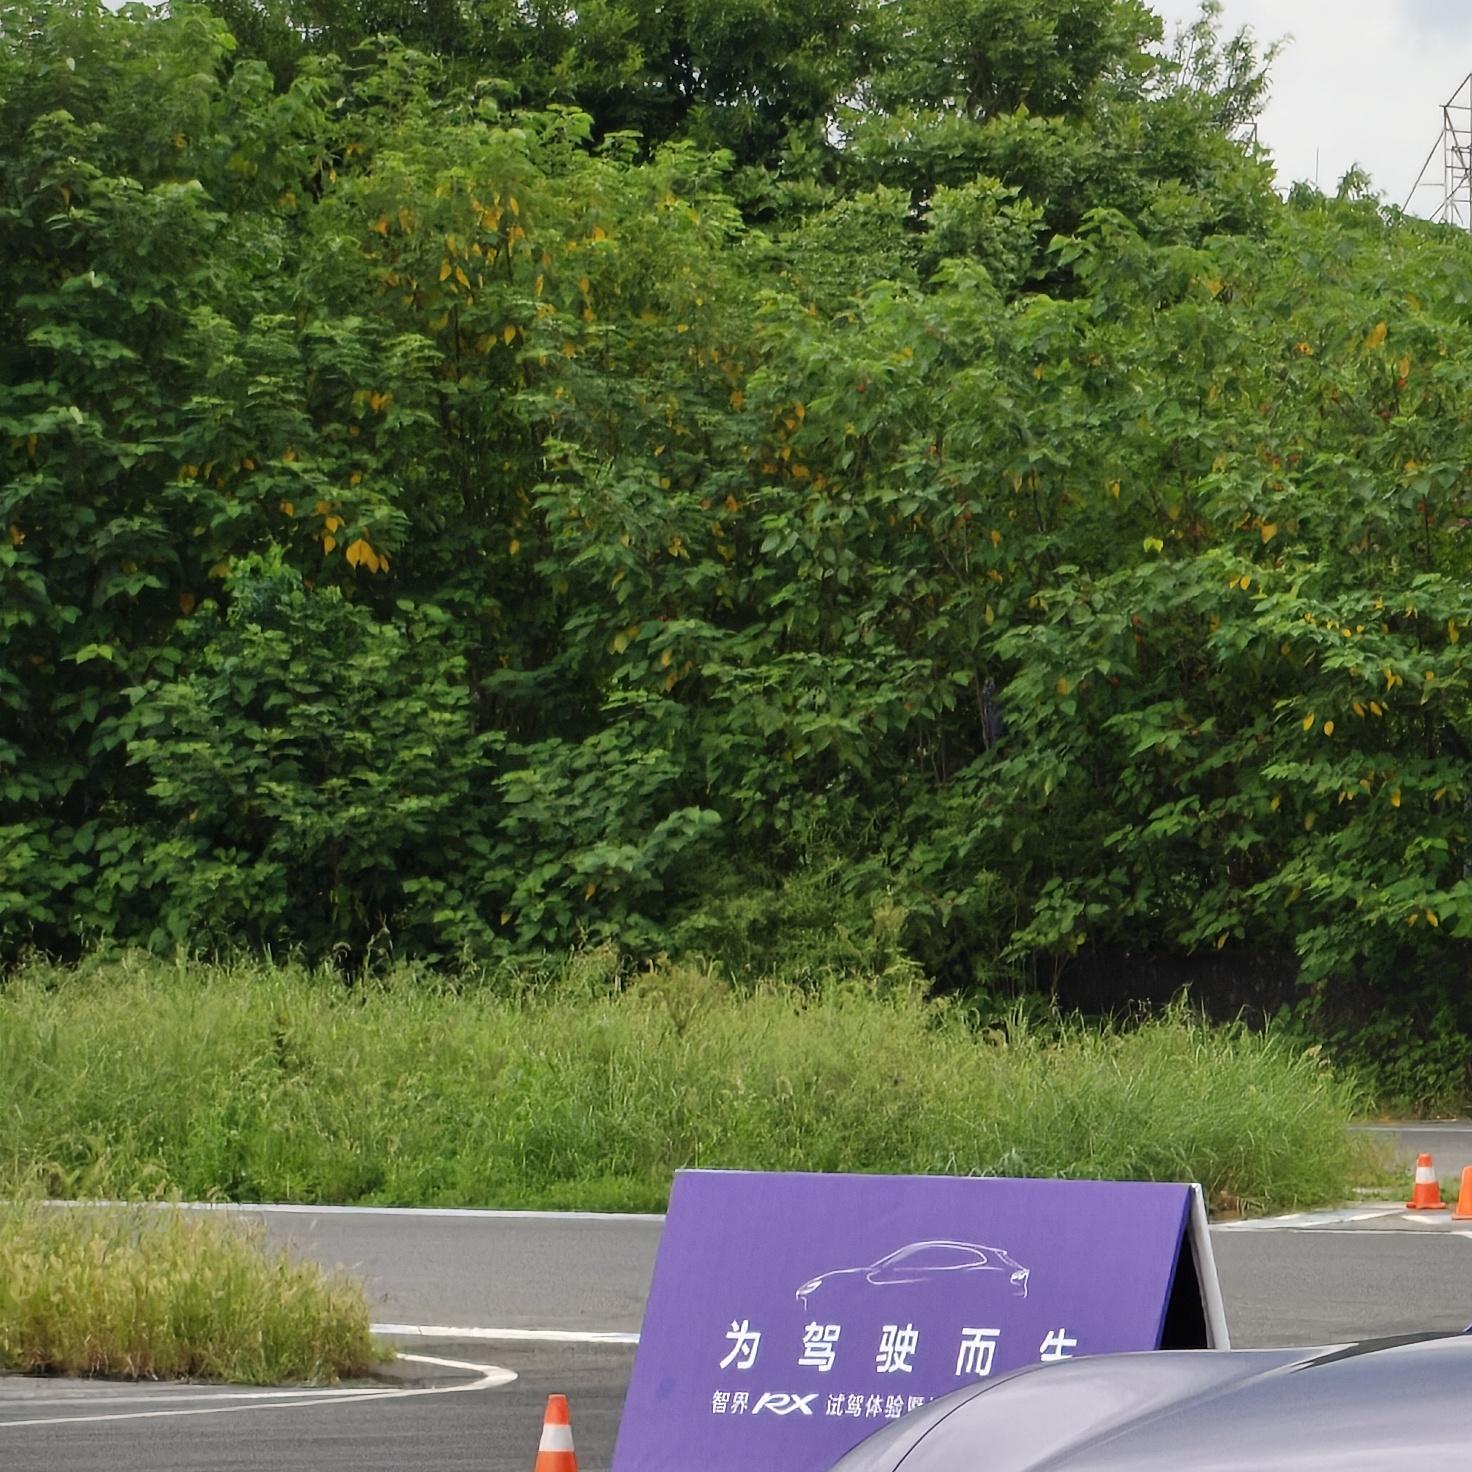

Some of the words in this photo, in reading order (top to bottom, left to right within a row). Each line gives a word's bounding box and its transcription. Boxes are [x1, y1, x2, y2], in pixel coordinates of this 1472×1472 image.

[719, 1319, 1078, 1377] 为驾驶而生
[712, 1390, 749, 1414] 智界
[751, 1392, 819, 1415] RX
[826, 1393, 934, 1418] 试驾体验
